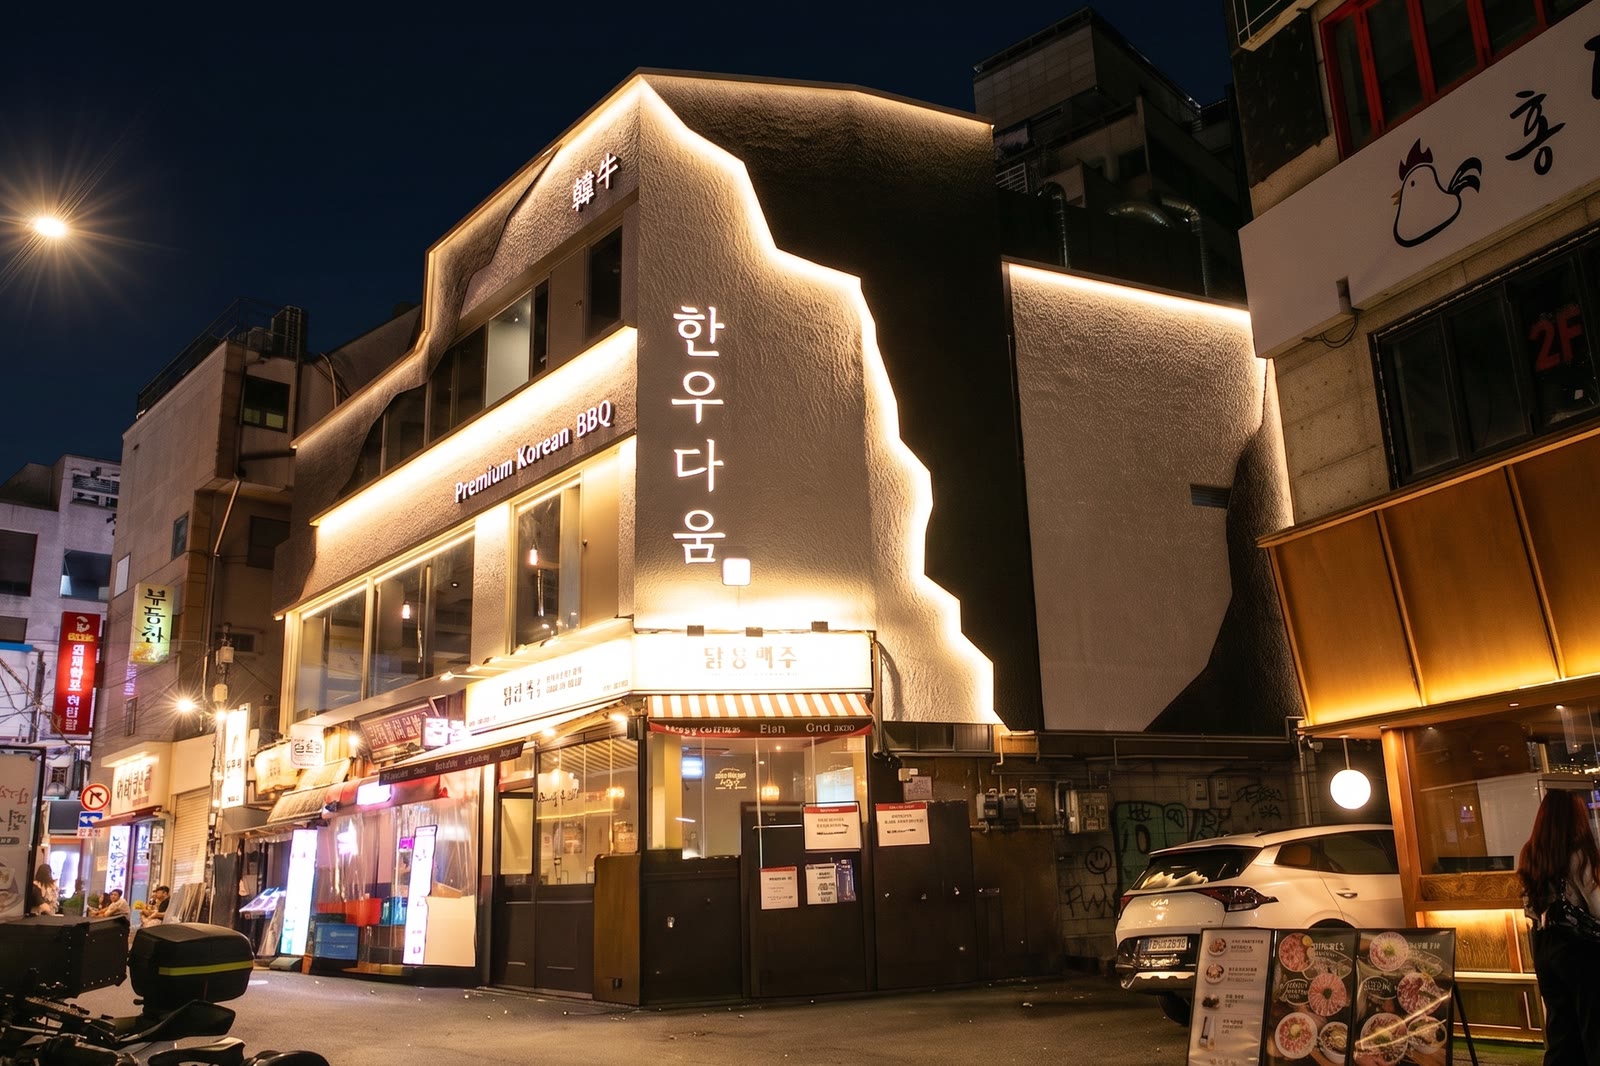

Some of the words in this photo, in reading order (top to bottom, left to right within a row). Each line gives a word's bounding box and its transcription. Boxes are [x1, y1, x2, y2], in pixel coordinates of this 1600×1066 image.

[571, 152, 619, 212] 韓牛
[1529, 304, 1583, 373] 2F
[455, 459, 513, 504] Premium
[516, 427, 570, 470] Korean
[576, 399, 612, 438] BBQ
[671, 305, 726, 565] 한우다움
